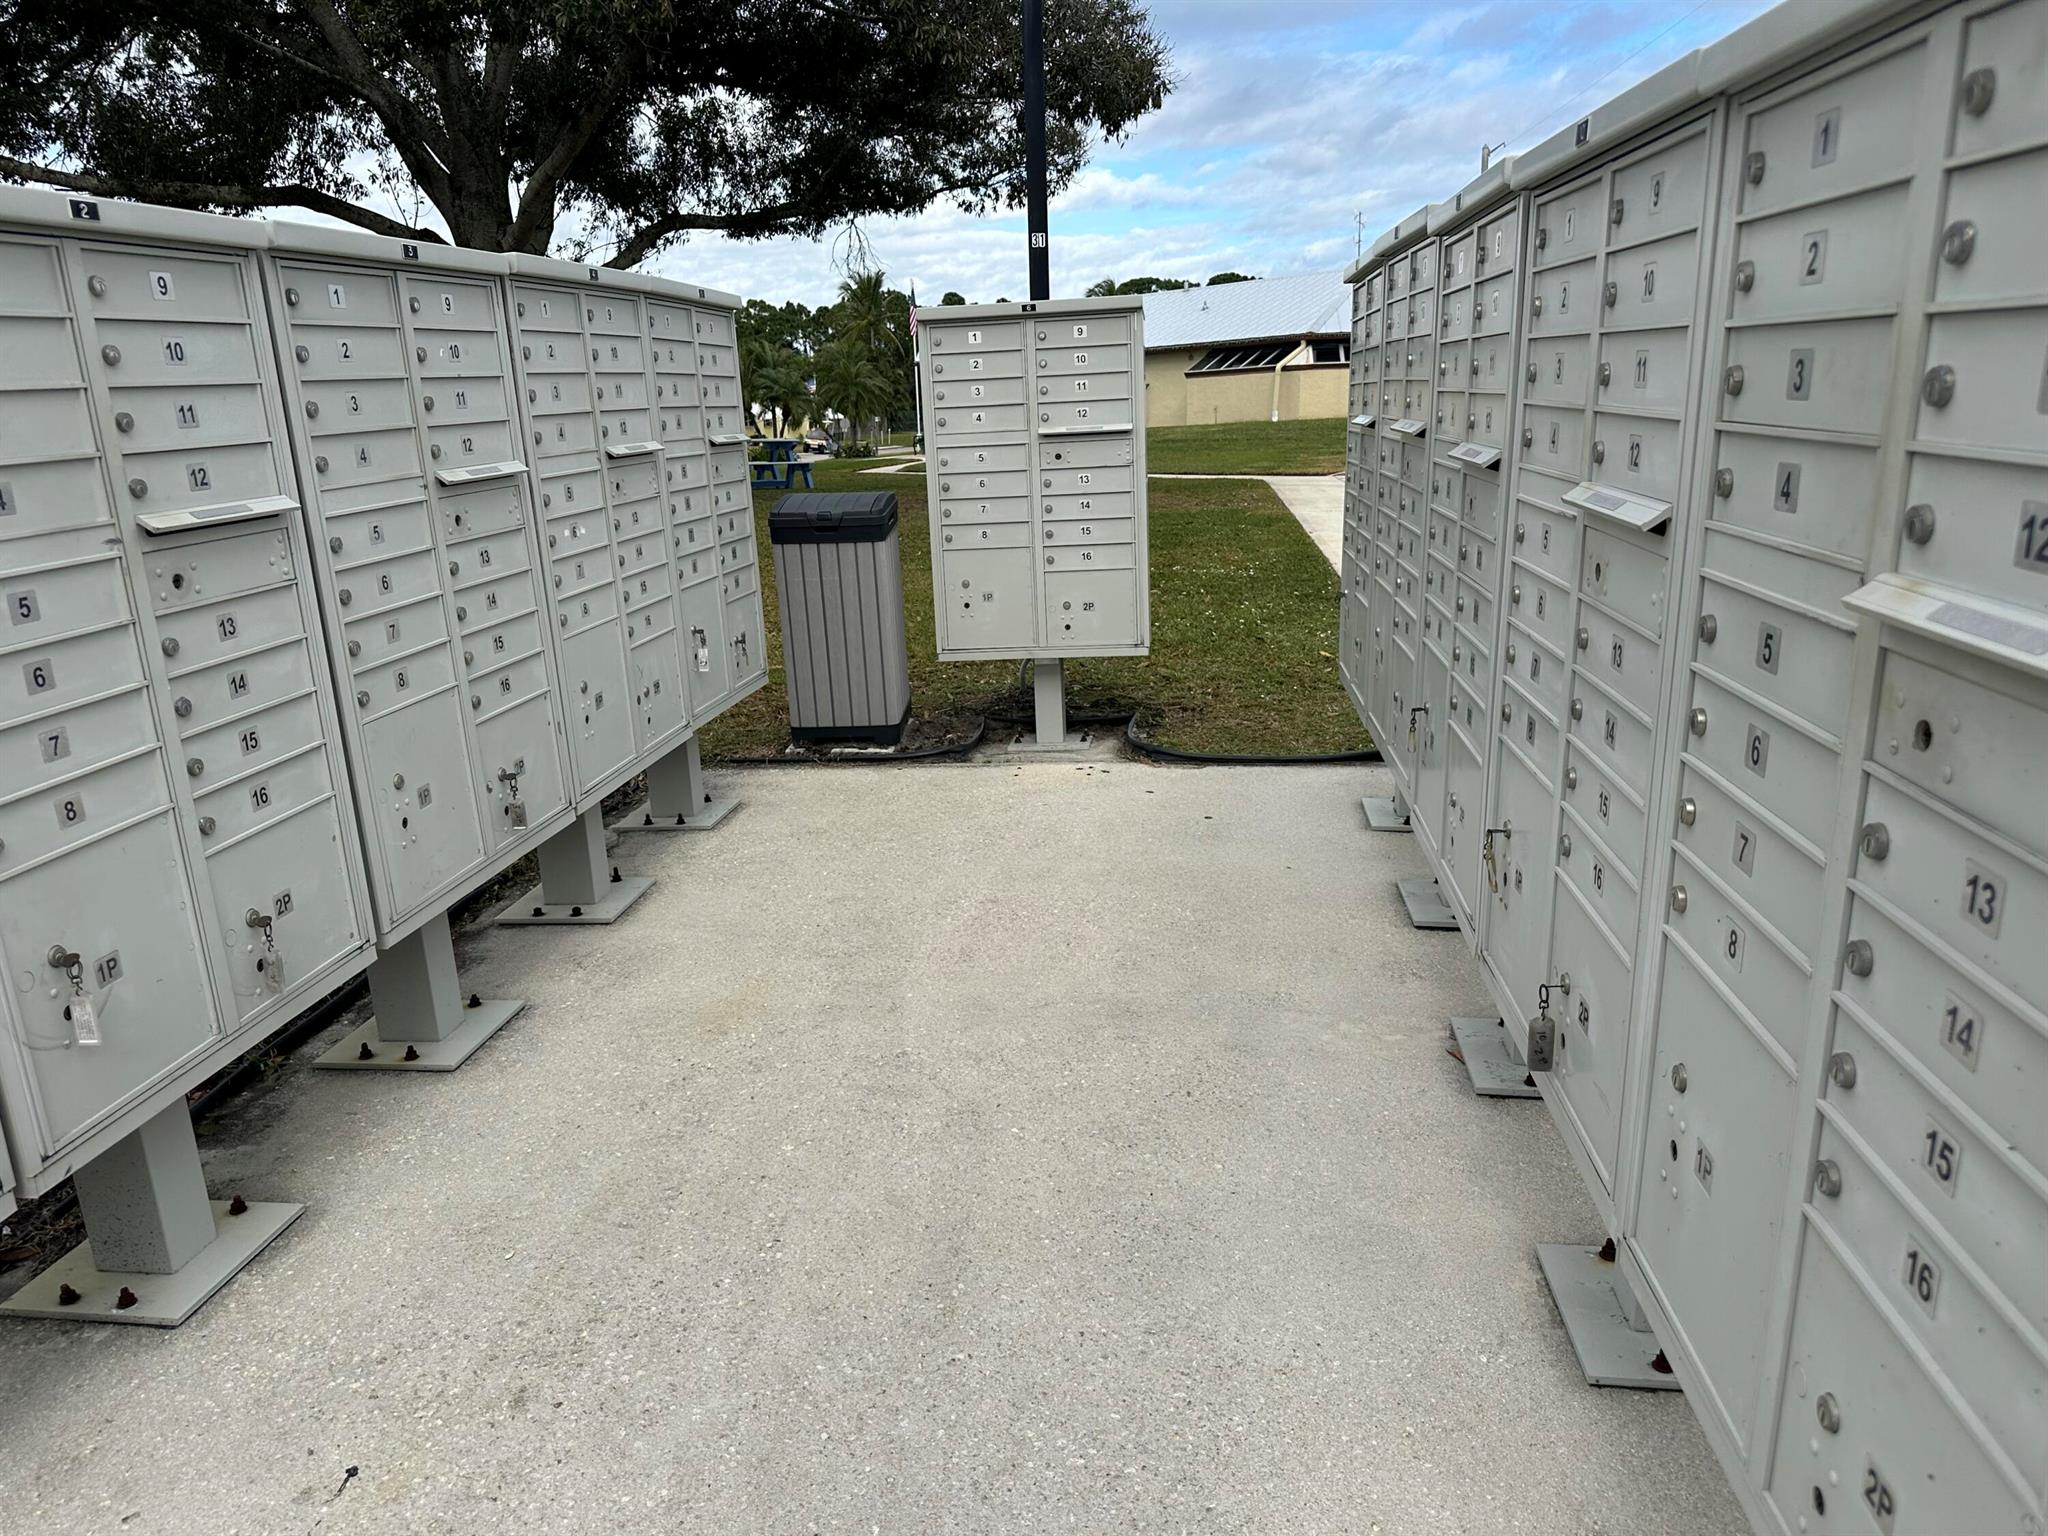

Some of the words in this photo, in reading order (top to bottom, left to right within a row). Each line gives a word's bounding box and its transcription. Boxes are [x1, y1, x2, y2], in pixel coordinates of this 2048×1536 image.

[1820, 120, 1830, 155] 1
[1653, 179, 1661, 207] 9
[79, 203, 91, 219] 2
[1566, 212, 1572, 236] 1
[1032, 233, 1045, 247] 31
[407, 245, 414, 257] 3
[1806, 241, 1819, 277] 2
[157, 276, 168, 296] 9
[1643, 269, 1654, 297] 10
[333, 288, 341, 305] 1
[444, 296, 451, 312] 9
[1561, 286, 1567, 309] 2
[1077, 327, 1084, 337] 9
[165, 342, 184, 362] 10
[341, 342, 350, 359] 2
[449, 344, 460, 359] 10
[548, 344, 554, 358] 2
[1075, 354, 1087, 364] 10
[973, 360, 979, 369] 2
[1556, 358, 1562, 380] 3
[1637, 356, 1647, 382] 11
[1793, 358, 1805, 393] 3
[553, 385, 559, 399] 3
[615, 383, 623, 396] 11
[974, 387, 981, 397] 3
[1076, 381, 1086, 391] 11
[350, 395, 359, 412] 3
[455, 391, 466, 406] 11
[178, 404, 196, 424] 11
[975, 413, 982, 423] 4
[1077, 409, 1088, 418] 12
[619, 421, 628, 434] 12
[462, 437, 473, 453] 12
[360, 447, 368, 464] 4
[978, 453, 985, 463] 5
[1630, 442, 1640, 468] 12
[190, 467, 209, 488] 12
[979, 479, 986, 488] 6
[1079, 474, 1090, 484] 13
[1780, 471, 1792, 504] 4
[980, 505, 986, 514] 7
[1080, 501, 1091, 510] 14
[631, 511, 639, 523] 13
[373, 525, 380, 541] 5
[981, 530, 988, 540] 8
[1080, 526, 1092, 536] 15
[480, 549, 490, 565] 13
[636, 546, 643, 558] 14
[1081, 552, 1092, 561] 16
[381, 575, 389, 591] 6
[640, 580, 647, 593] 15
[487, 592, 497, 607] 14
[982, 593, 993, 602] 1P
[18, 596, 32, 619] 5
[1083, 602, 1095, 611] 2P
[219, 617, 236, 637] 13
[388, 623, 396, 640] 7
[493, 635, 504, 650] 15
[1762, 632, 1774, 665] 5
[1612, 642, 1623, 668] 13
[33, 666, 46, 688] 6
[230, 673, 247, 694] 14
[397, 672, 405, 688] 8
[500, 678, 511, 693] 16
[1605, 718, 1616, 743] 14
[48, 735, 60, 757] 7
[241, 731, 258, 751] 15
[1751, 735, 1761, 766] 6
[252, 786, 269, 807] 16
[418, 787, 431, 806] 1P
[1599, 791, 1609, 818] 15
[64, 800, 77, 822] 8
[1738, 832, 1749, 863] 7
[1593, 863, 1603, 890] 16
[275, 893, 291, 917] 2P
[1966, 874, 1996, 925] 13
[1728, 929, 1738, 960] 8
[97, 957, 118, 983] 1P
[1578, 1001, 1589, 1027] 2P
[1947, 1006, 1974, 1055] 14
[1697, 1148, 1712, 1181] 1P
[1926, 1130, 1954, 1182] 15
[1907, 1250, 1933, 1303] 16
[1864, 1468, 1894, 1517] 2P
